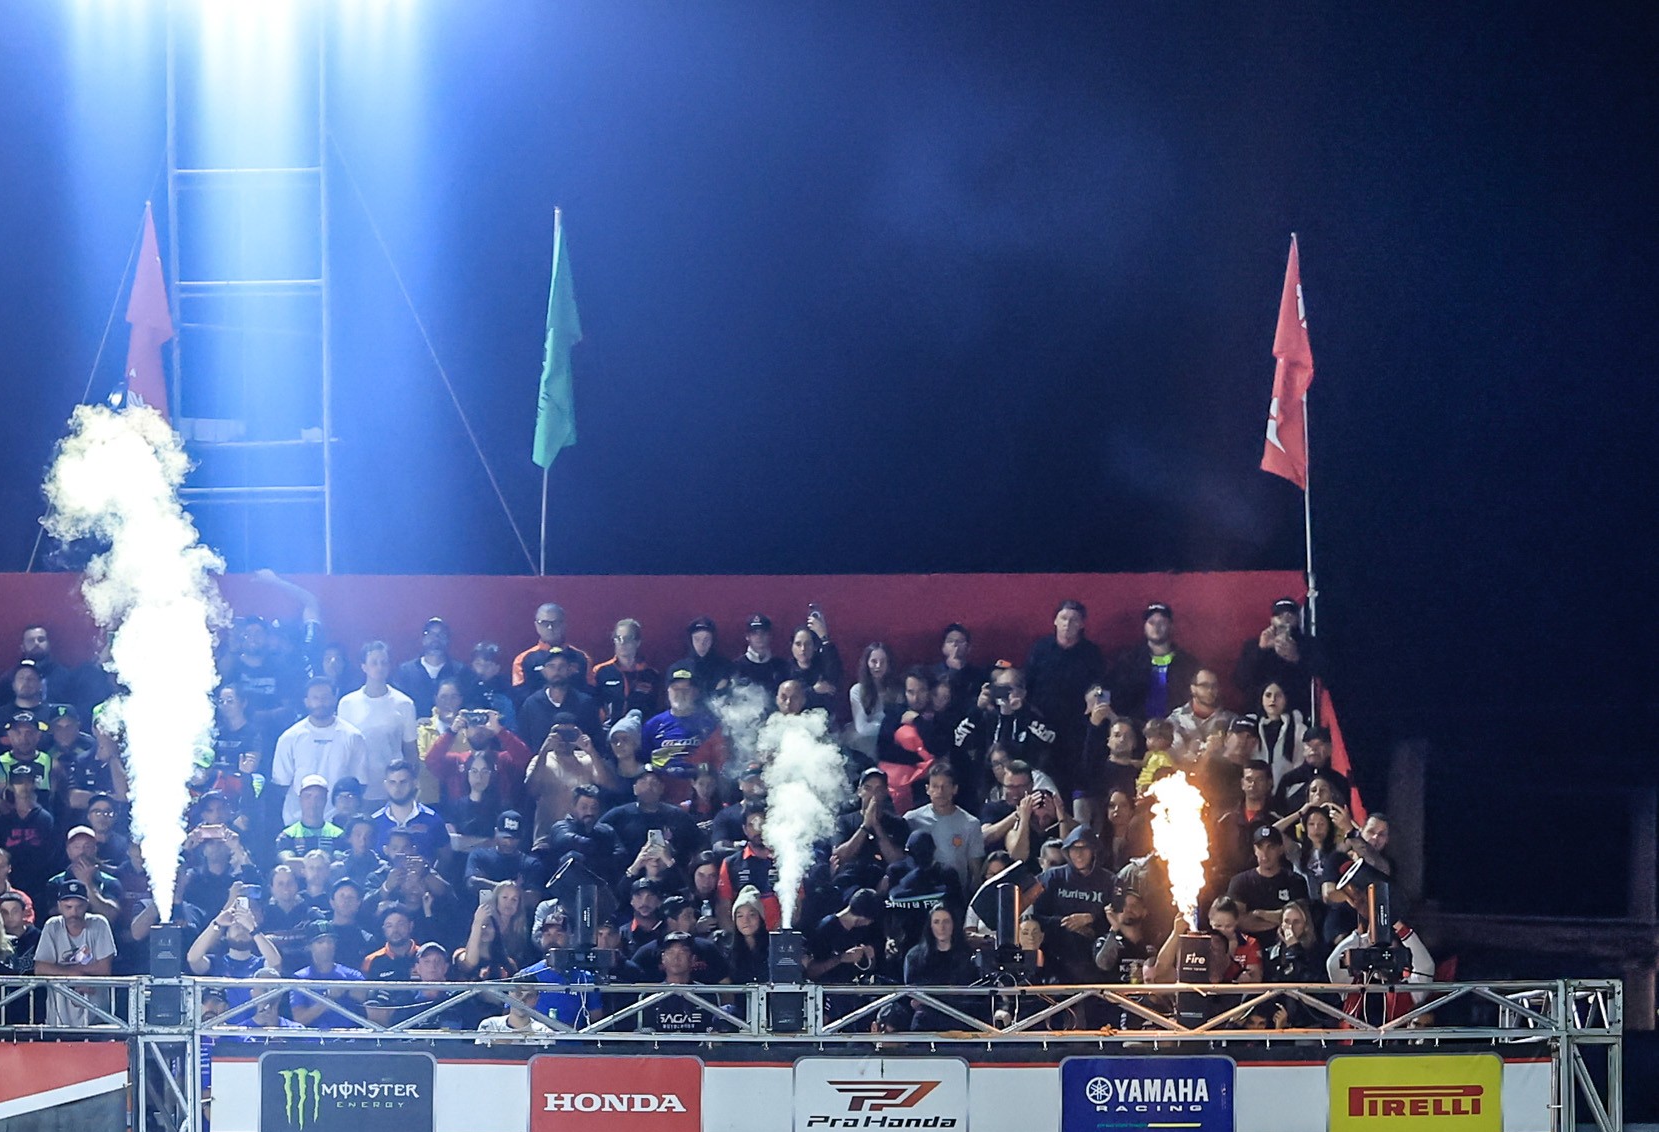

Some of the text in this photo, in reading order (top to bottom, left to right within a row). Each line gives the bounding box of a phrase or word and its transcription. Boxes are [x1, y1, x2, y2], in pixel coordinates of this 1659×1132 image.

[1058, 888, 1090, 900] Hurley
[1185, 952, 1206, 965] Fire
[321, 1081, 420, 1099] MONSTER
[1113, 1078, 1209, 1103] YAMAHA
[543, 1092, 687, 1113] HONDA
[1348, 1085, 1484, 1116] PIRELLI
[807, 1115, 858, 1128] Pro
